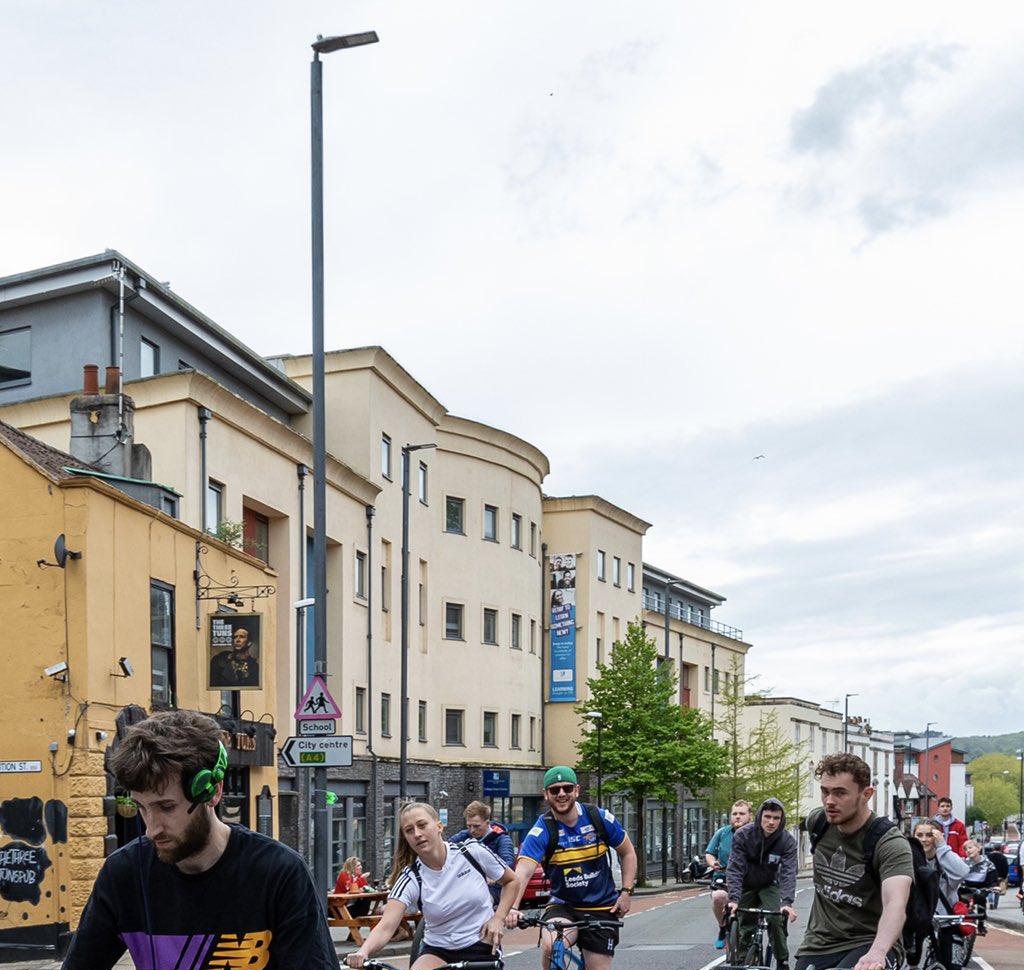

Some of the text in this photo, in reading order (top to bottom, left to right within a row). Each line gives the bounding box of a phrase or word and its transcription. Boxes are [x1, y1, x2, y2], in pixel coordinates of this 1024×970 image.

[302, 723, 332, 731] School
[298, 741, 348, 750] City centre
[301, 753, 325, 763] (A4)
[564, 874, 584, 882] Leeds
[566, 880, 589, 888] Society
